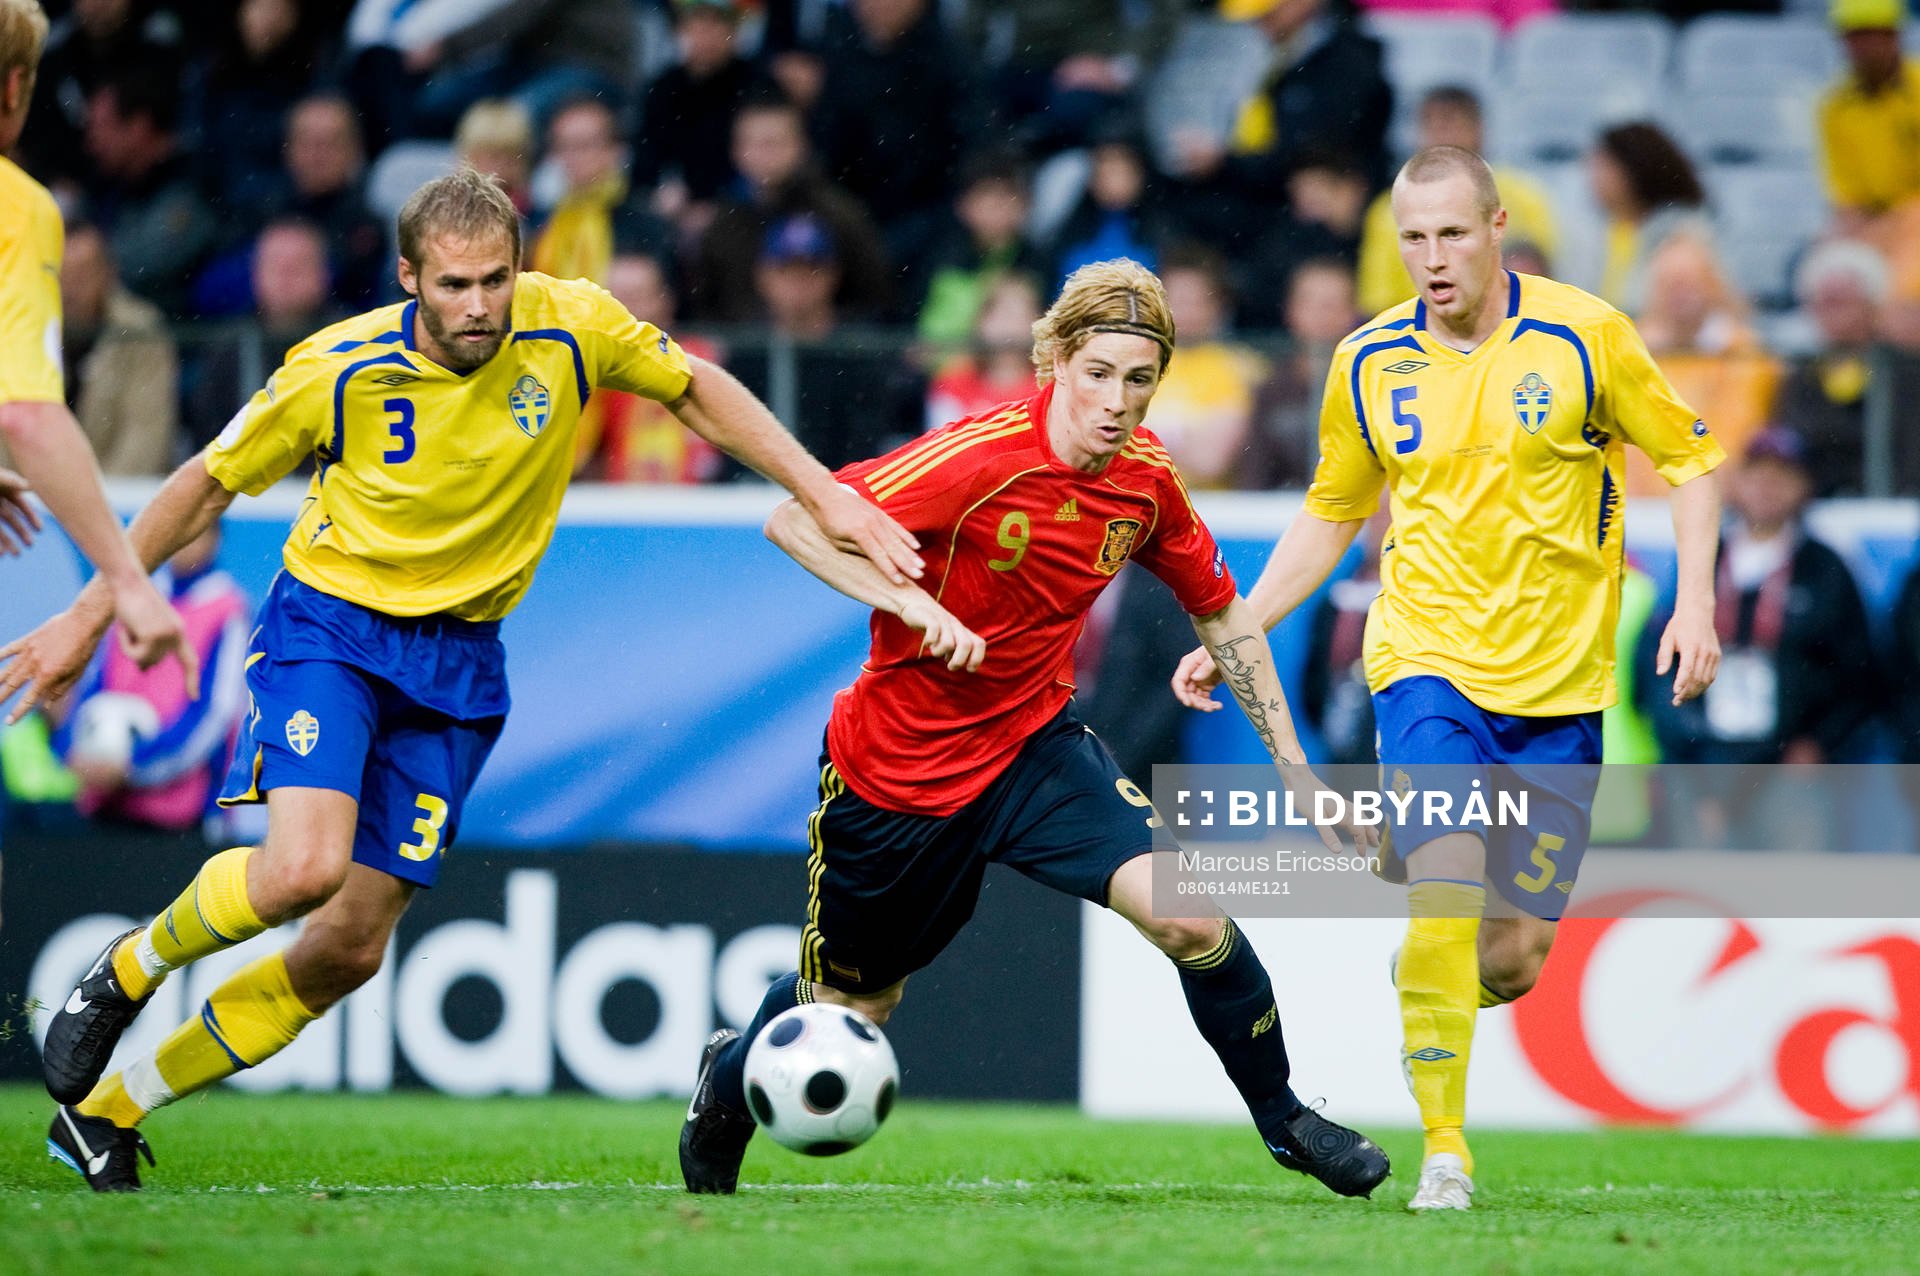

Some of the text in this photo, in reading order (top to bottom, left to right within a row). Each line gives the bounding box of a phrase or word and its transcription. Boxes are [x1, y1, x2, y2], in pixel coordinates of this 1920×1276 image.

[384, 398, 416, 464] 3
[1391, 385, 1423, 455] 5
[988, 511, 1031, 572] 9
[398, 793, 449, 862] 3
[1513, 832, 1567, 894] 5
